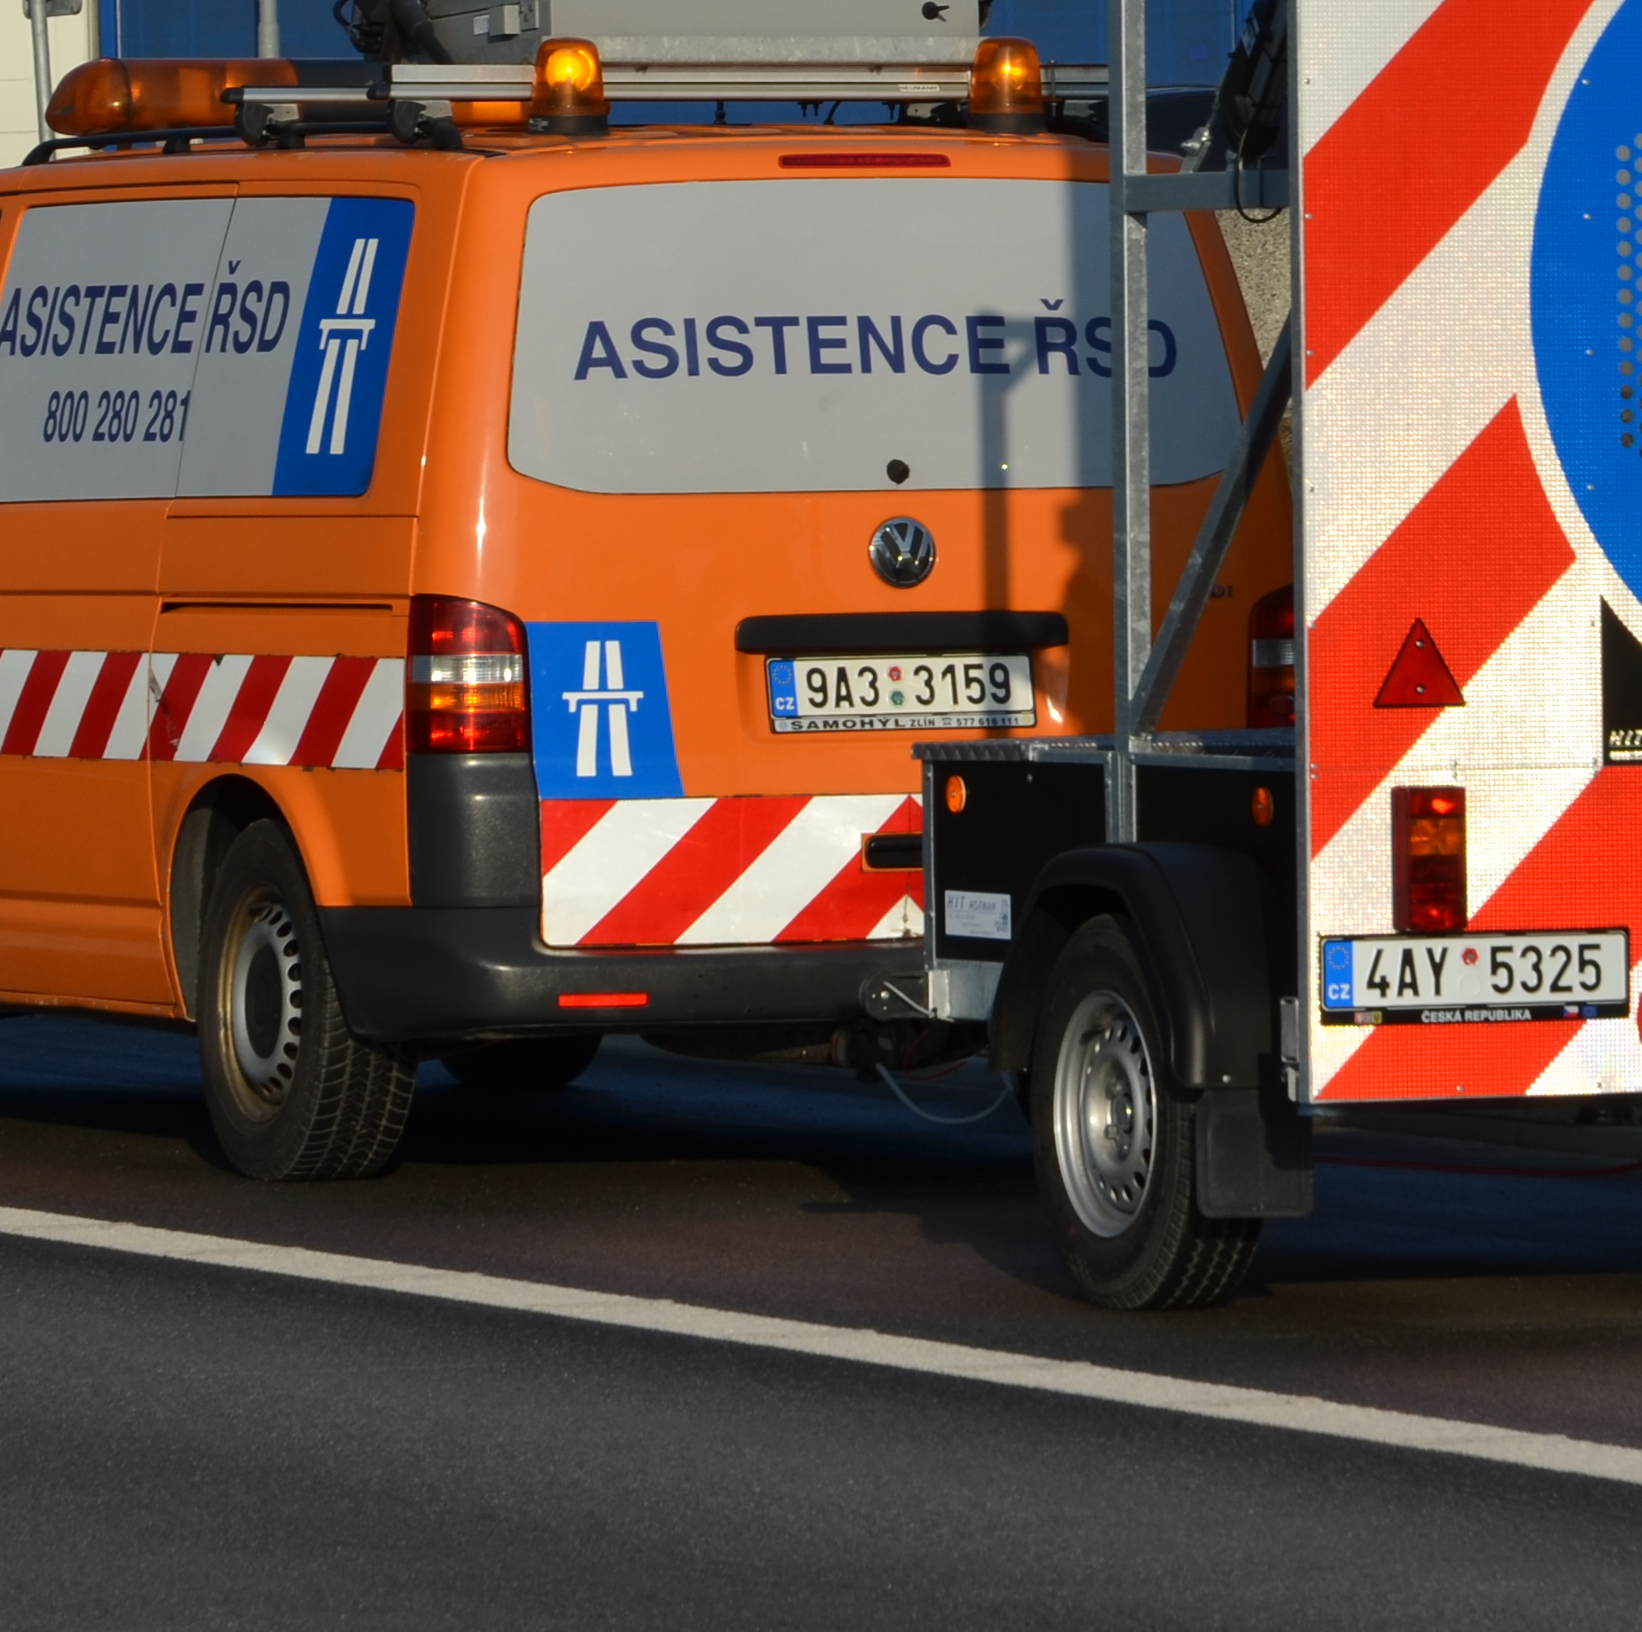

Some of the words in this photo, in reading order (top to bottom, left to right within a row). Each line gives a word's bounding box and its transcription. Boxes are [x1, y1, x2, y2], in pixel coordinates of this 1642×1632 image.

[204, 259, 291, 355] ŘSD
[573, 313, 1011, 381] ASISTENCE
[42, 389, 89, 443] 800
[92, 389, 140, 443] 280
[143, 389, 192, 443] 281
[775, 696, 795, 711] CZ
[805, 665, 880, 709] 9A3
[912, 661, 1012, 707] 3159
[790, 717, 906, 731] SAMOHÝL
[909, 715, 936, 728] ZLÍN
[957, 717, 976, 727] 577
[1000, 715, 1020, 726] 111
[1327, 984, 1351, 1001] CZ
[1365, 946, 1449, 1000] 4AY
[1489, 942, 1603, 996] 5325
[1420, 1008, 1462, 1024] ČESKÁ
[1463, 1007, 1532, 1023] REPUBLIKA
